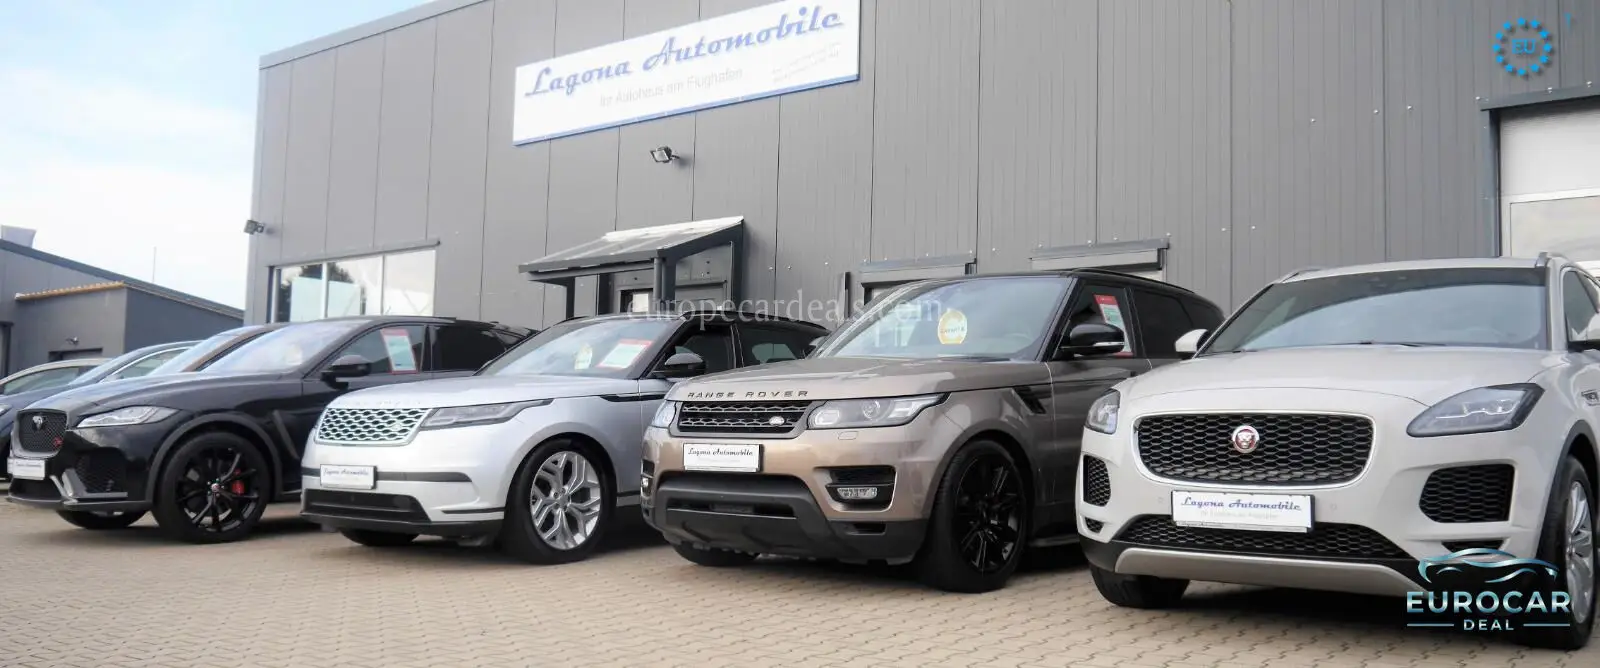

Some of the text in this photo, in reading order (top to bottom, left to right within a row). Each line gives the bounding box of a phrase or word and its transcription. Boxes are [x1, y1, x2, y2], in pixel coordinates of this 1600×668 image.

[523, 65, 633, 97] Lagona
[642, 4, 846, 72] Automobile
[687, 67, 743, 90] Flughafen
[745, 390, 809, 398] ROVER
[1180, 496, 1303, 511] Lagona Automobile
